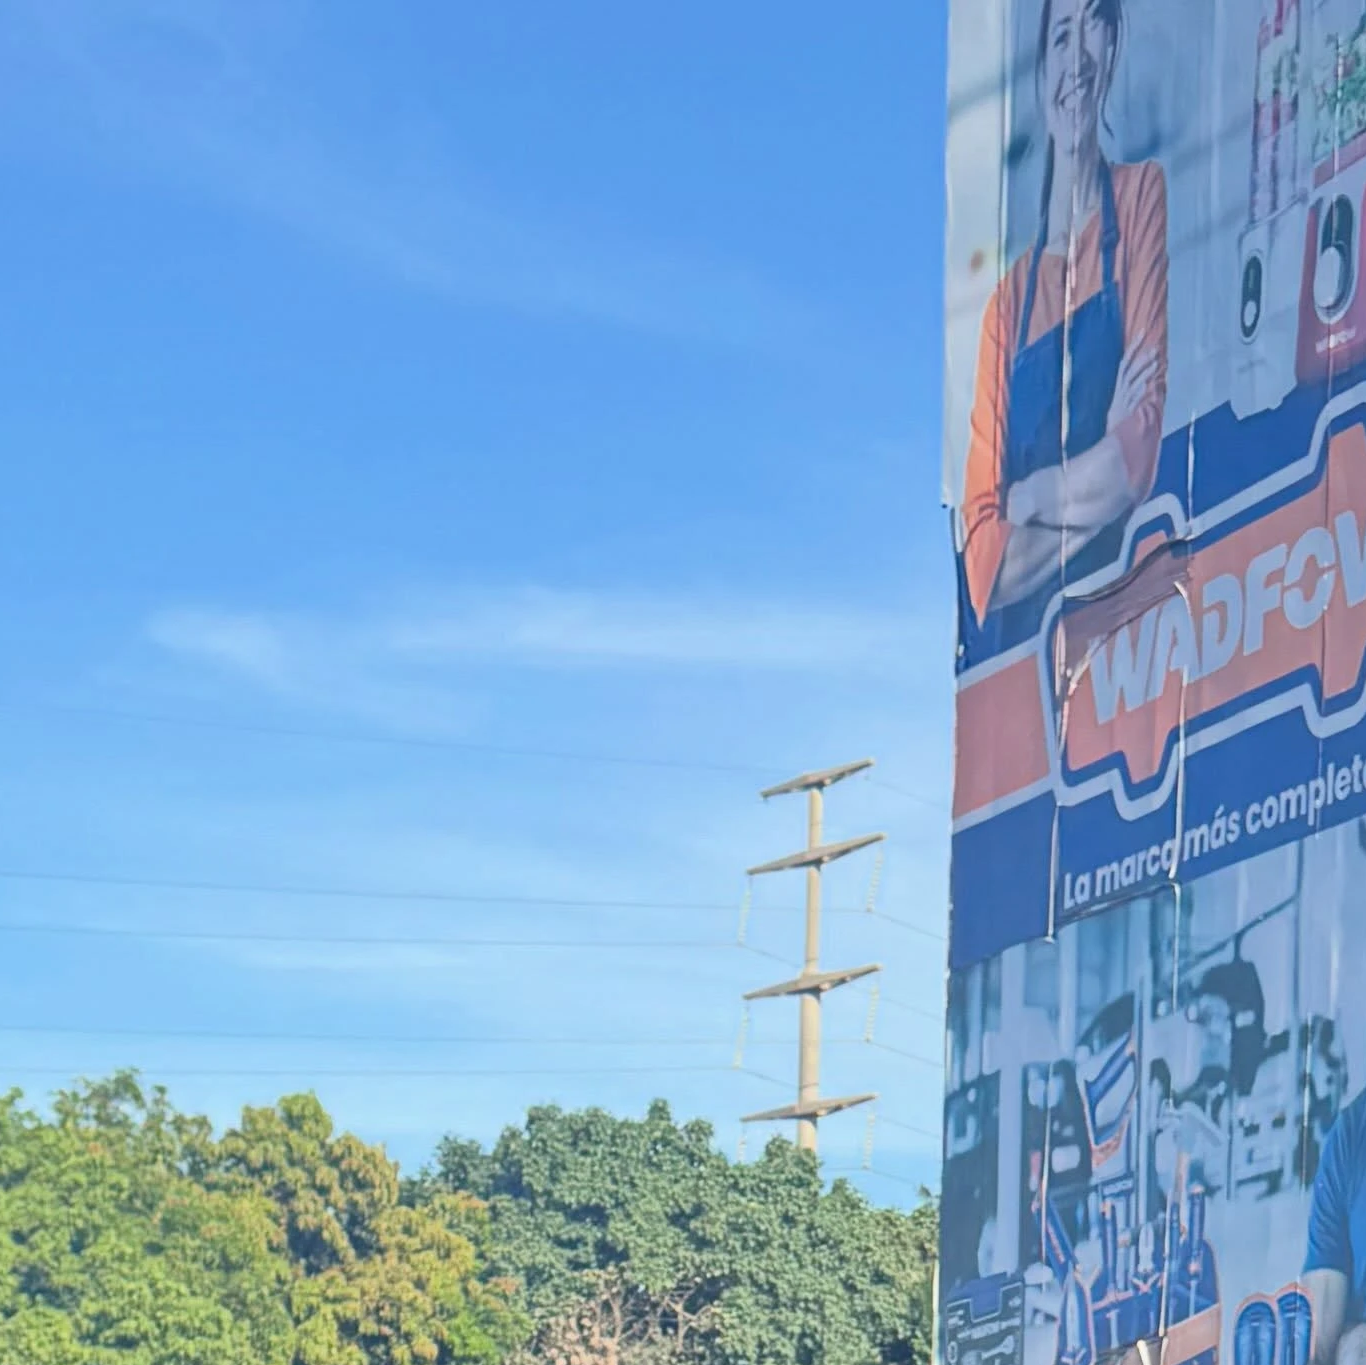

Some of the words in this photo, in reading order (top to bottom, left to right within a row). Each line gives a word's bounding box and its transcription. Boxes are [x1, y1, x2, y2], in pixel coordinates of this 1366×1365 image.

[1063, 872, 1091, 910] La
[1095, 839, 1177, 897] marca
[1183, 804, 1240, 862] más
